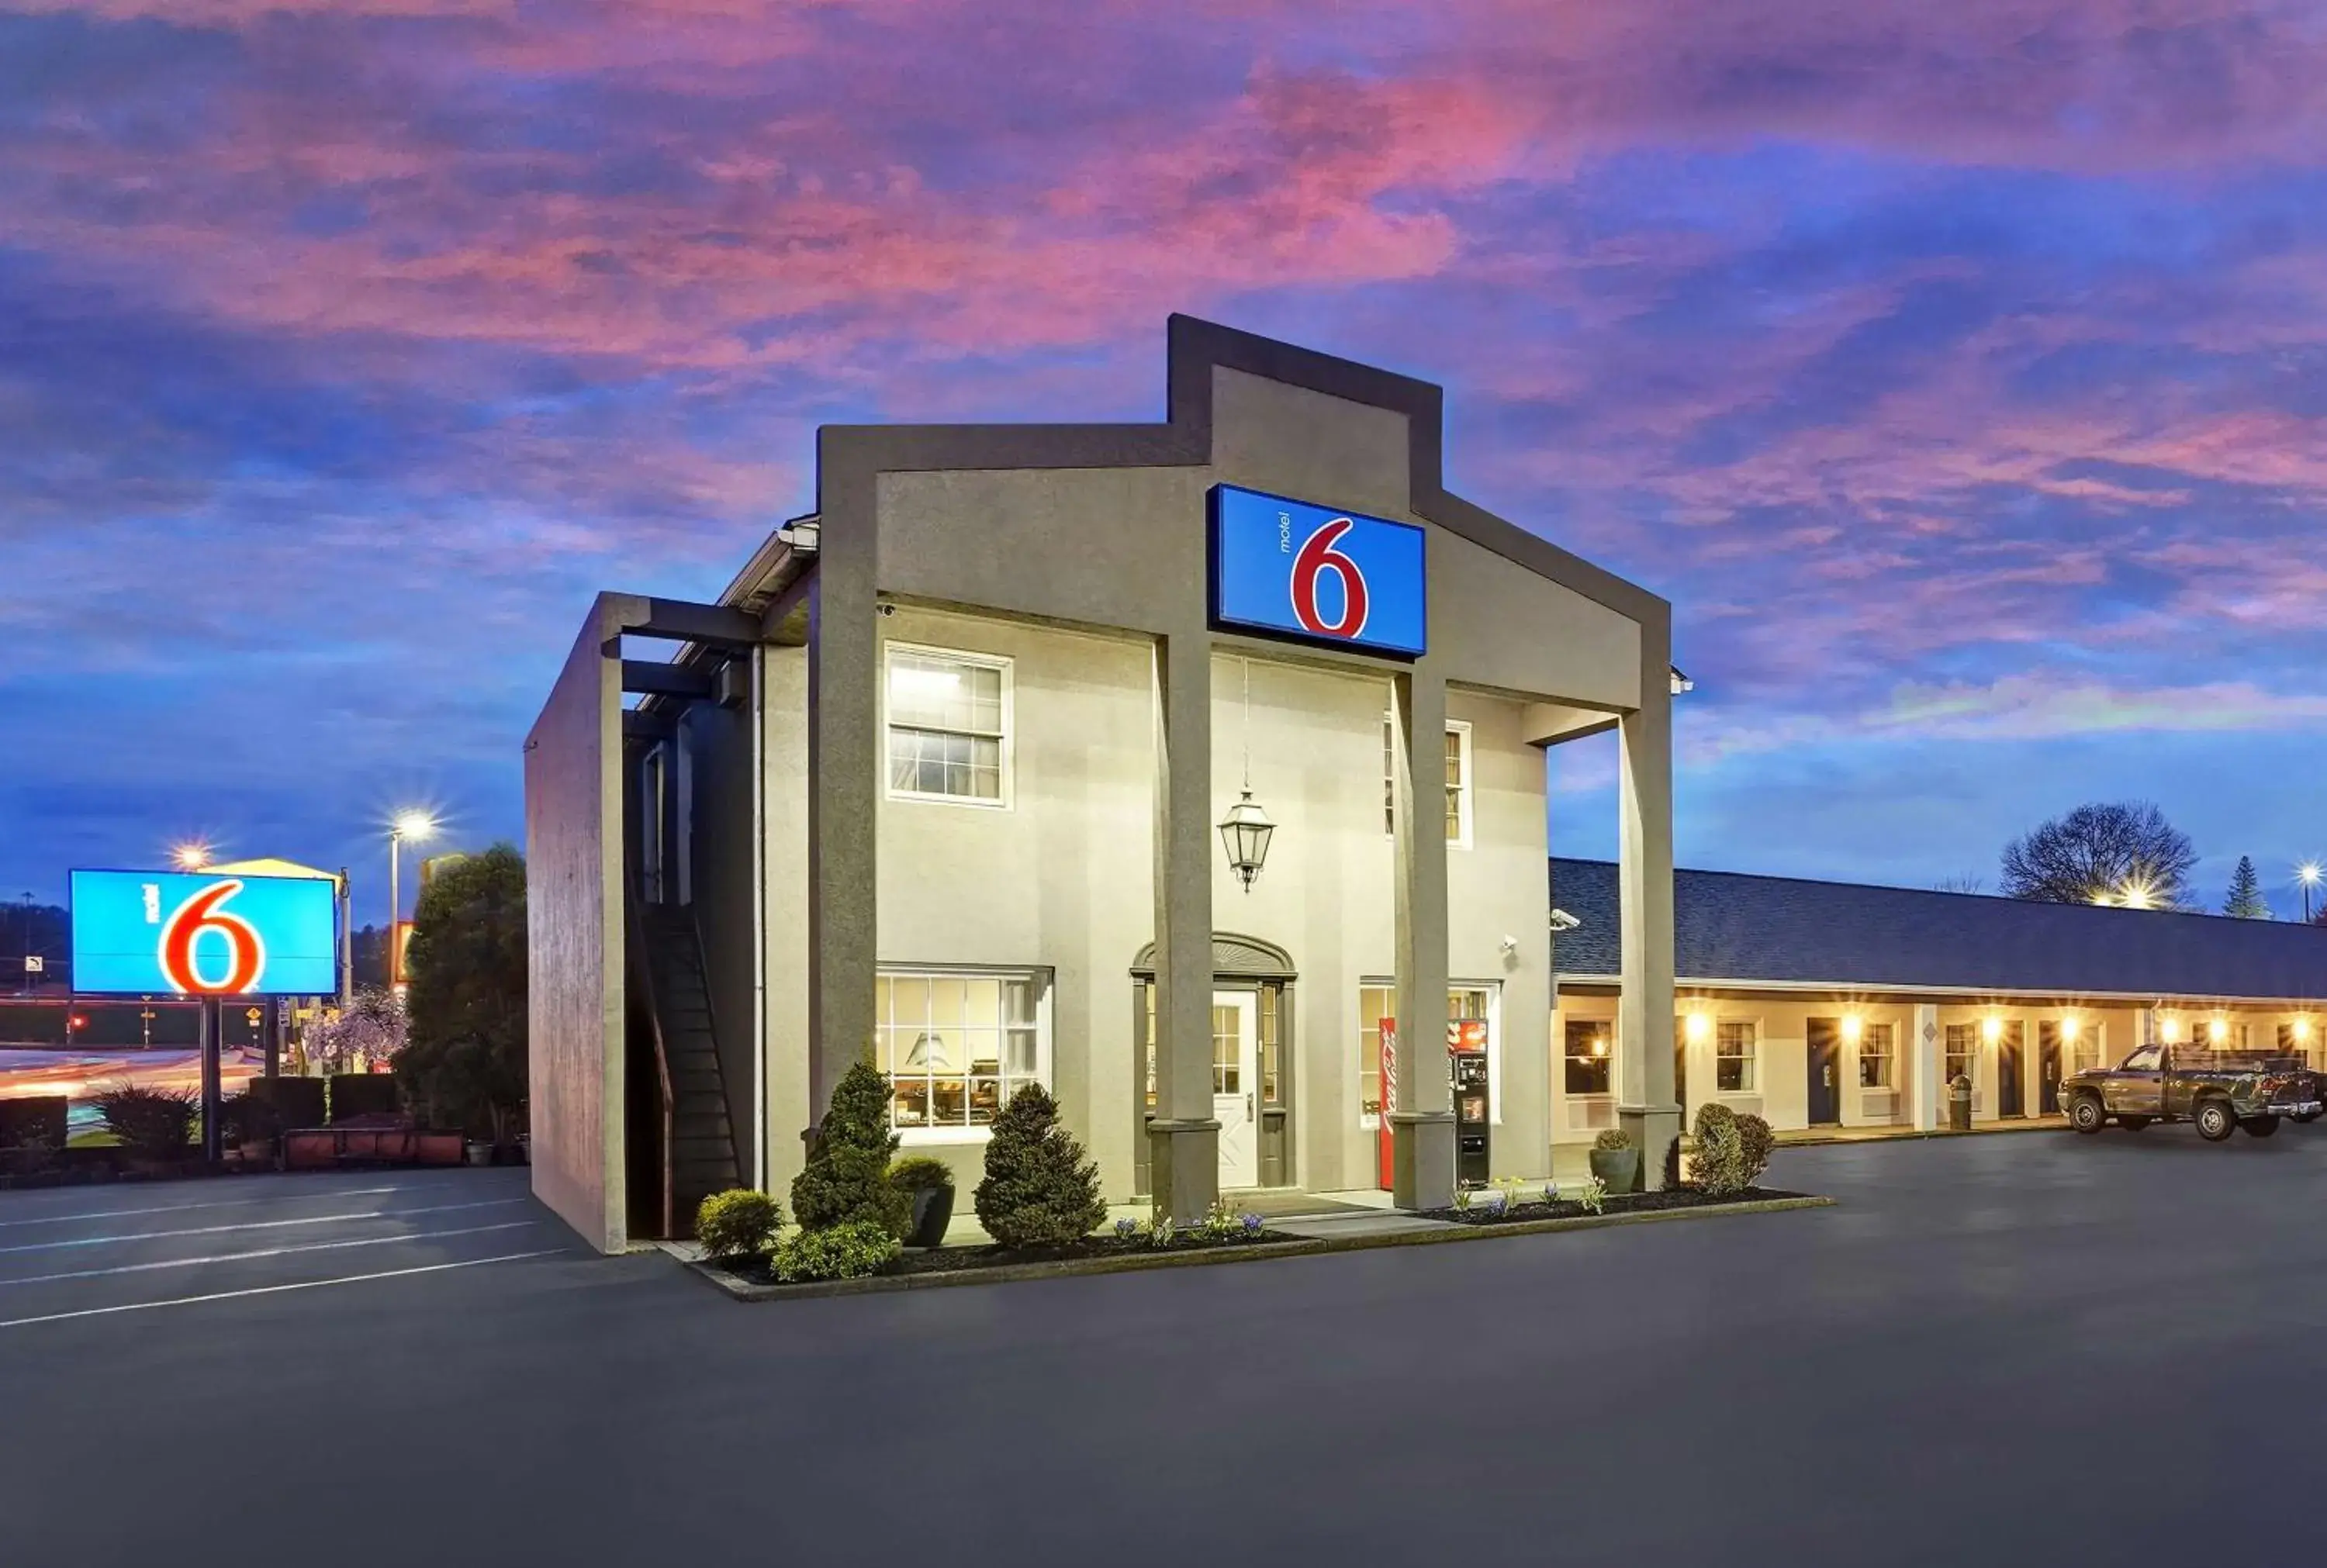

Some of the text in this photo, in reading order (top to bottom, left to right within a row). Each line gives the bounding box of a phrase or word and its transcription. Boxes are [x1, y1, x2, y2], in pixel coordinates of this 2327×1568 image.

[1278, 511, 1290, 553] motel
[1291, 517, 1368, 639] 6
[158, 879, 265, 993] 6
